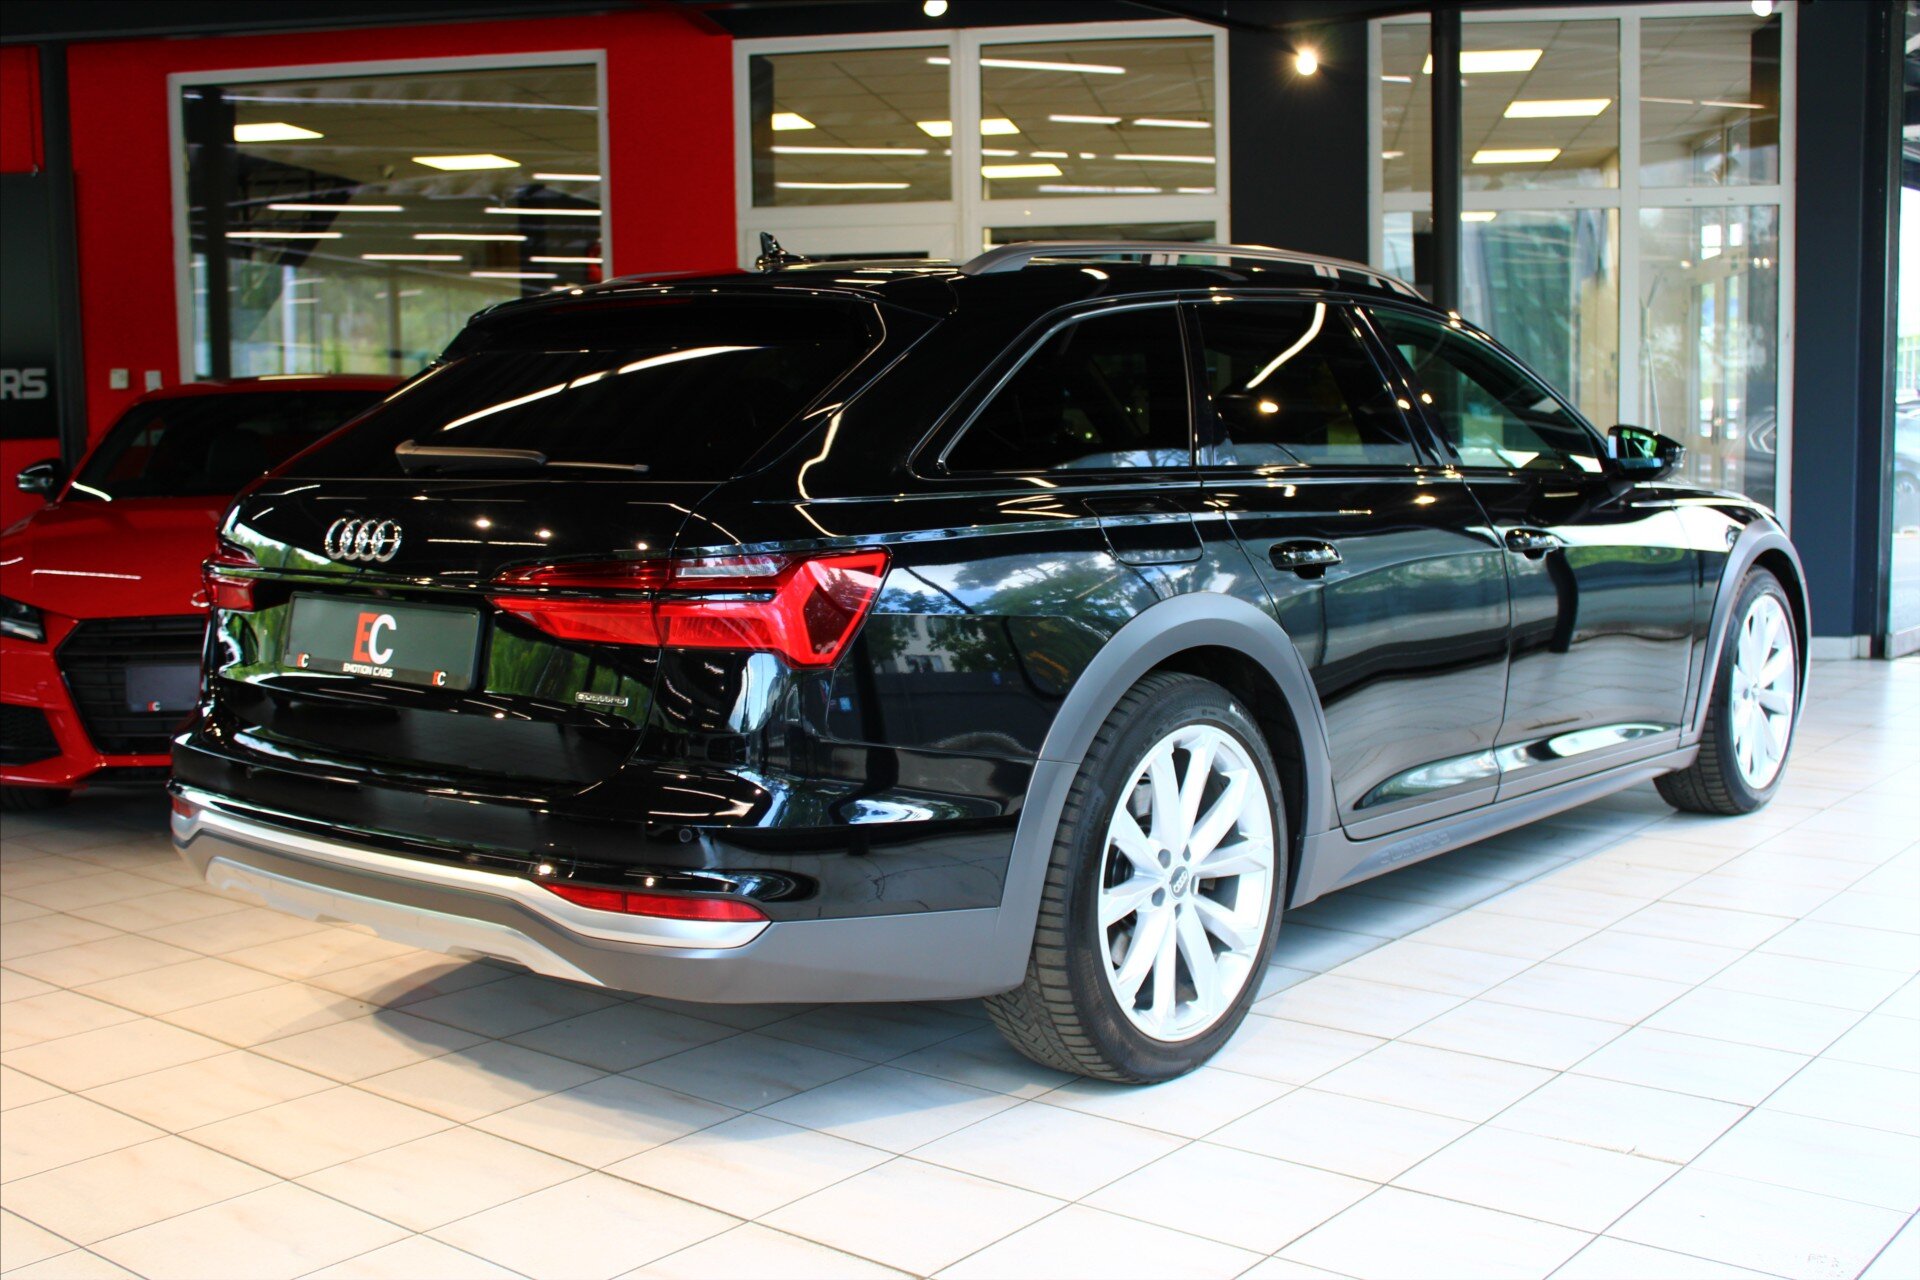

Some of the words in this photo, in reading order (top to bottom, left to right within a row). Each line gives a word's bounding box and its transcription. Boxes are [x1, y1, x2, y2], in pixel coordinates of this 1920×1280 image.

[352, 612, 397, 665] EC
[343, 663, 373, 675] EMOTION
[373, 667, 394, 678] CARS
